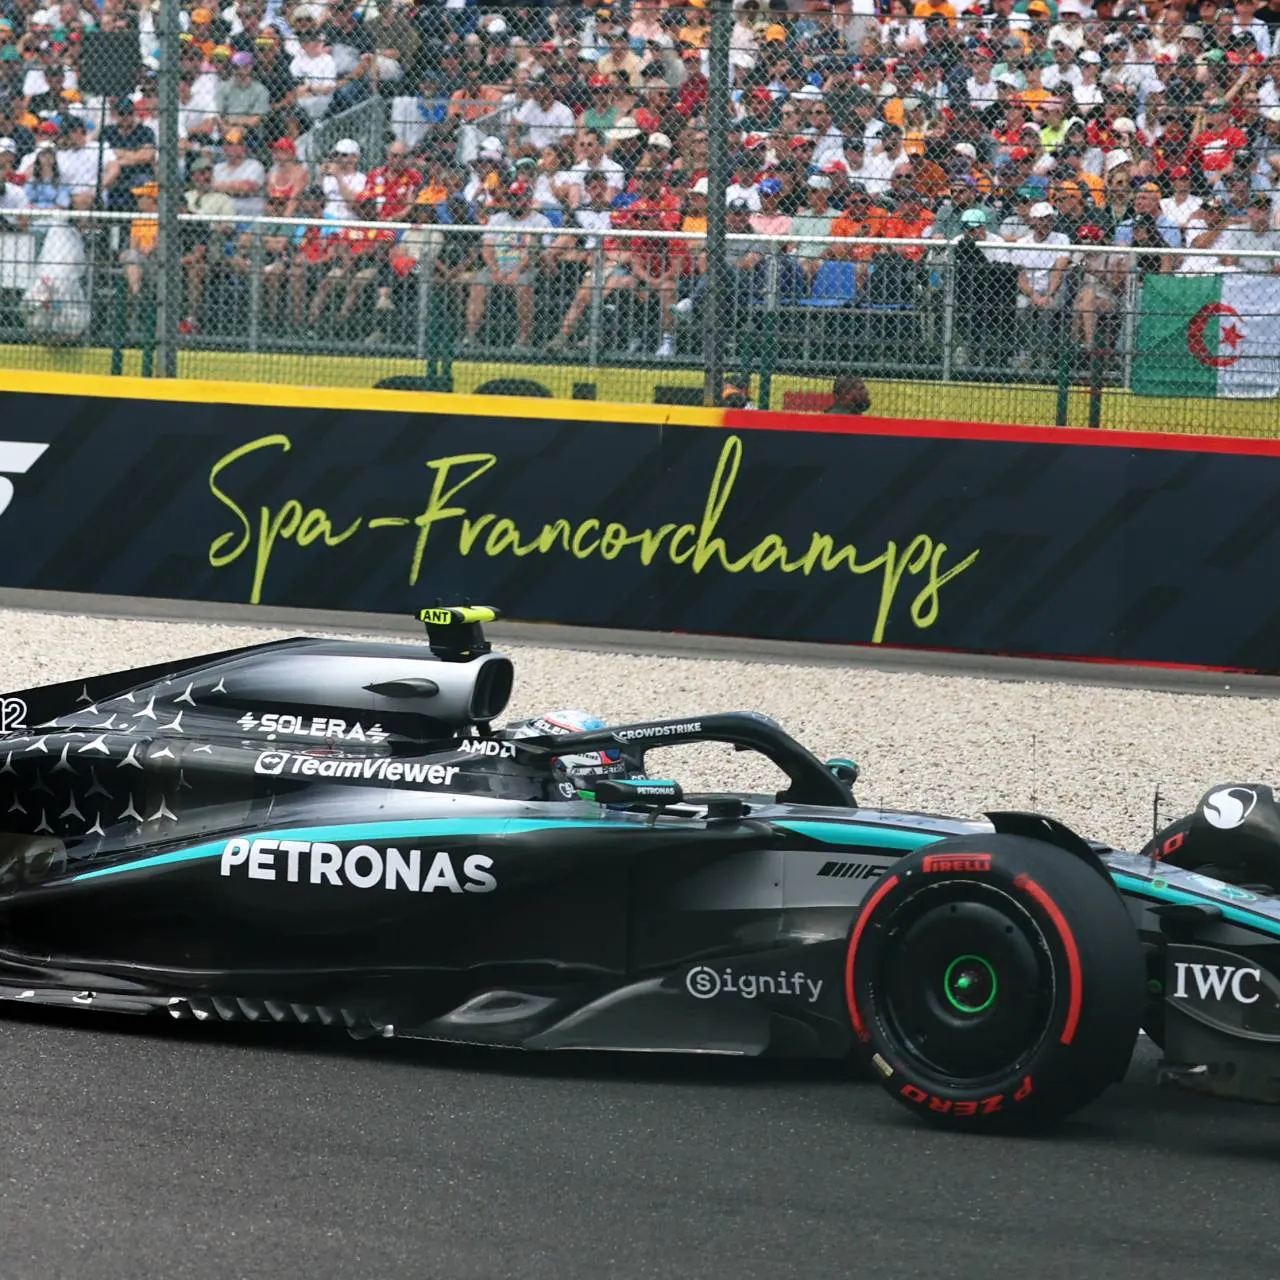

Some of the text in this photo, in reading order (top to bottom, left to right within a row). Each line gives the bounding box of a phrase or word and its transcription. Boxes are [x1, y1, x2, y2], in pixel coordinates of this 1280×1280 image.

[208, 433, 980, 644] Spa-Francorchamps
[423, 610, 449, 623] ANT
[258, 713, 367, 742] SOLERA
[619, 722, 702, 741] CROWDSTRIKE
[455, 739, 501, 757] AMD
[290, 754, 460, 786] TeamViewer
[636, 786, 675, 796] PETRONAS
[220, 838, 498, 894] PETRONAS
[922, 852, 992, 873] PIRELLI
[1173, 961, 1262, 1005] IWC
[899, 1084, 1005, 1116] ZERO
